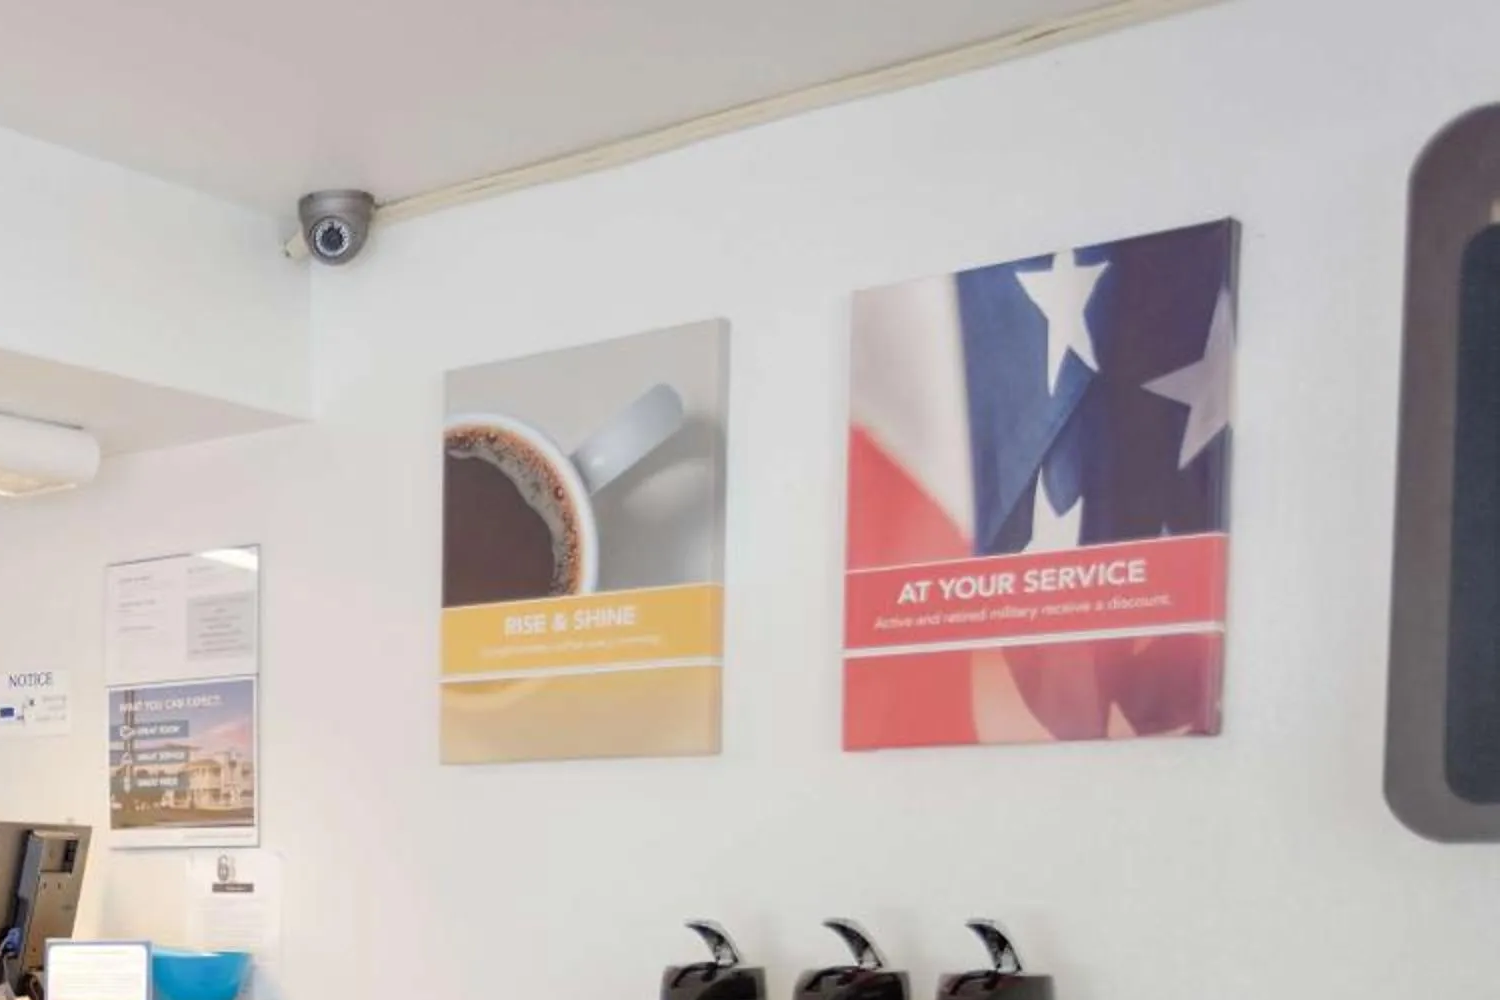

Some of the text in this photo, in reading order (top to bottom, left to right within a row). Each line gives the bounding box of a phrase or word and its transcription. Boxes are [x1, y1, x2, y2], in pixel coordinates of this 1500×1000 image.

[897, 559, 1147, 605] AT YOUR SERVICE
[504, 612, 547, 636] RISE
[573, 605, 638, 631] SHINE
[916, 612, 941, 627] and
[989, 604, 1037, 621] military
[8, 671, 53, 688] NOTICE
